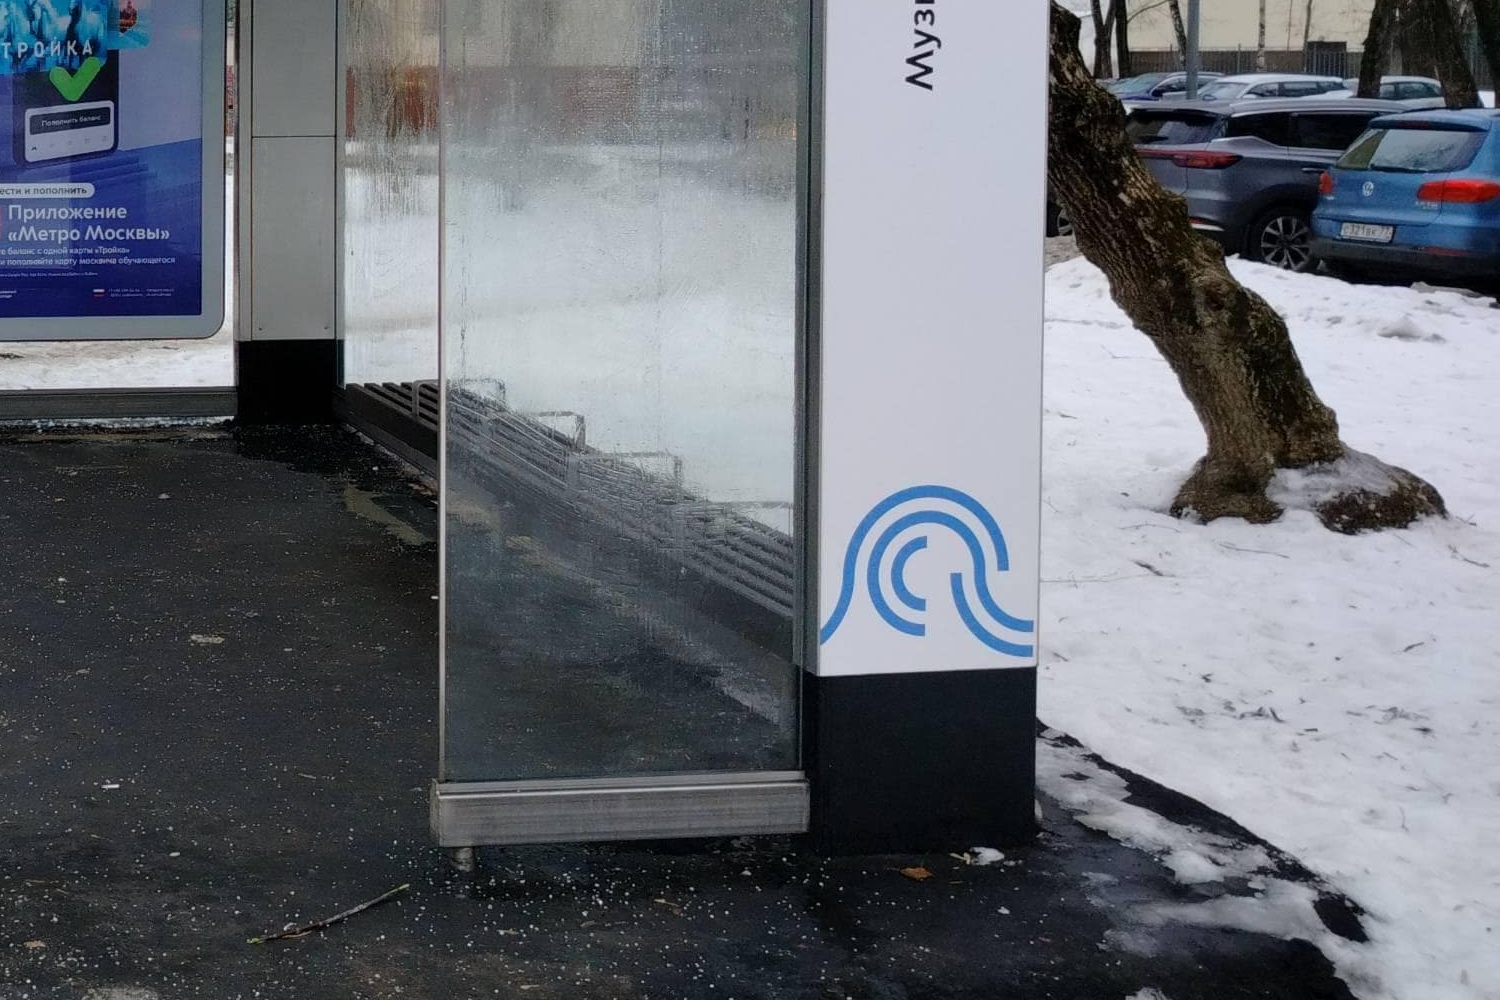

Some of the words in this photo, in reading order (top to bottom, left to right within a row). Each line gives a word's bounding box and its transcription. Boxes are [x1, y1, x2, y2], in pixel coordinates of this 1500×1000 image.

[1, 37, 94, 59] ТРОЙКА
[24, 187, 31, 195] и
[33, 186, 88, 195] пополнить
[8, 205, 128, 223] Приложение
[8, 225, 80, 244] «Метро
[84, 225, 171, 241] Москвы»
[7, 246, 36, 256] баланс
[43, 246, 68, 256] одной
[69, 248, 93, 256] карты
[54, 258, 78, 266] карту
